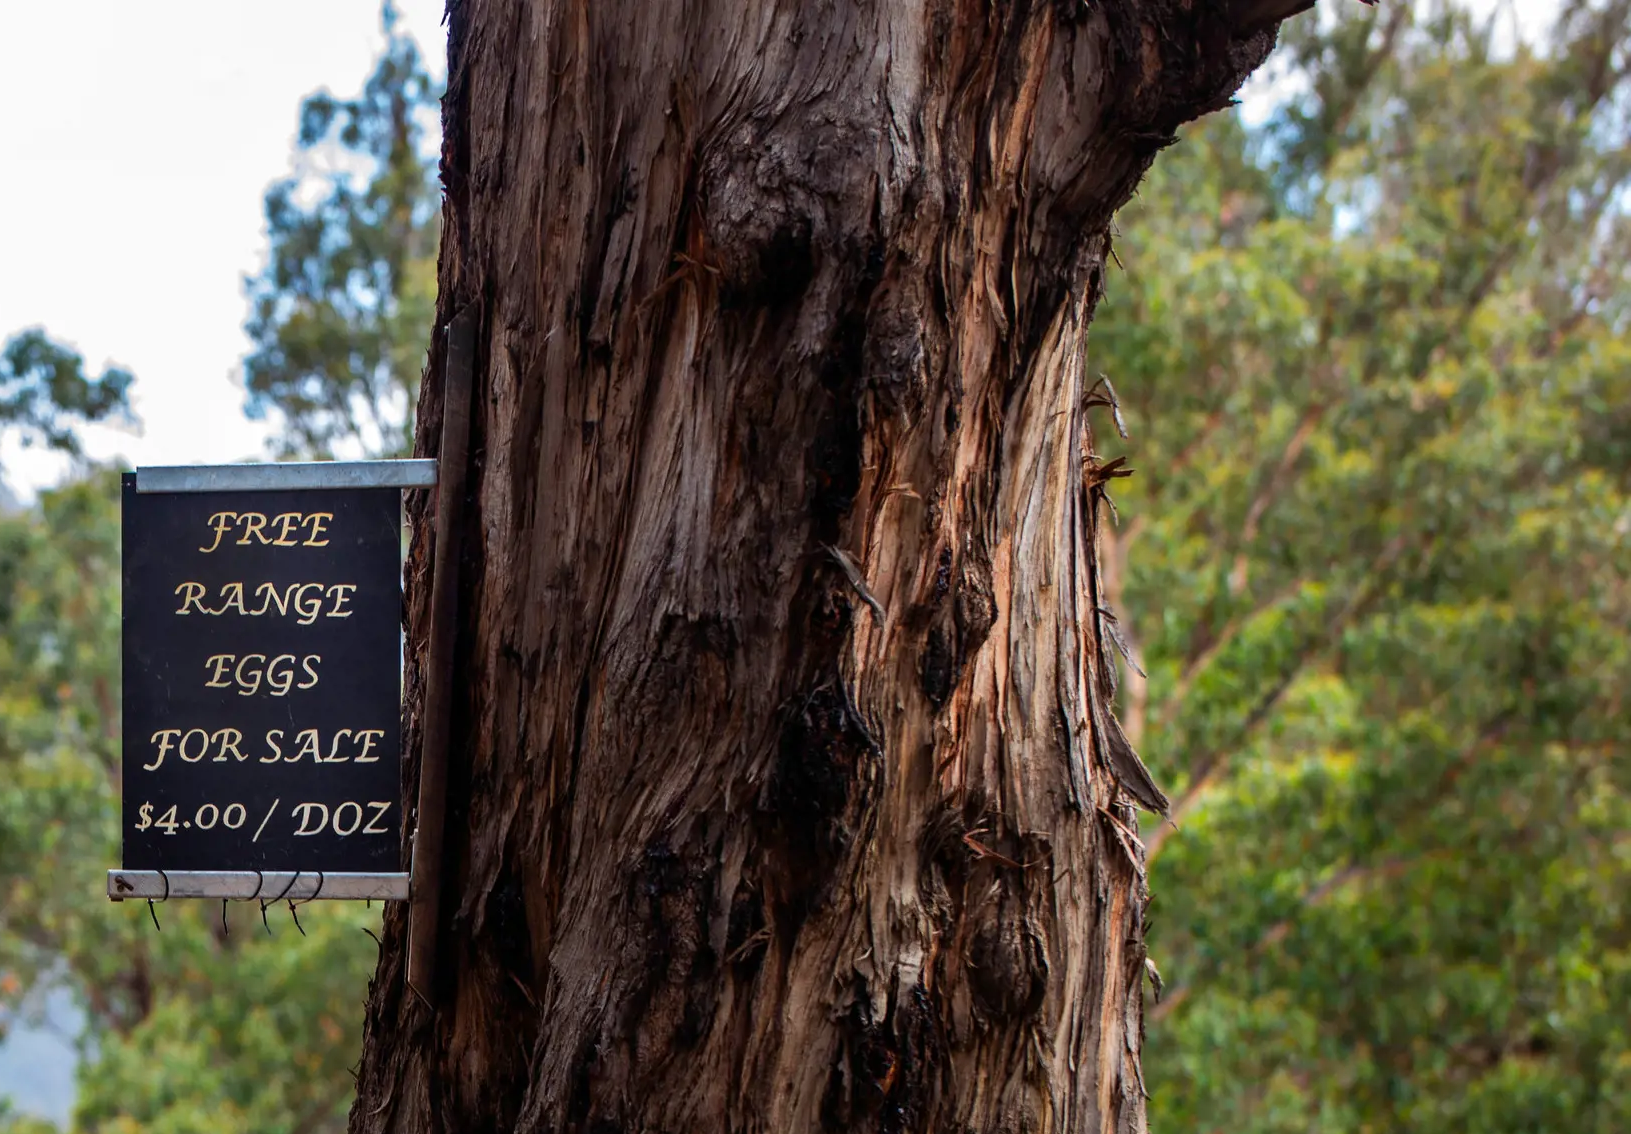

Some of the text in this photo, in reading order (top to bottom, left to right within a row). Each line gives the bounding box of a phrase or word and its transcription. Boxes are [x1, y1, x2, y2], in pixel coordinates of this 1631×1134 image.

[199, 511, 334, 554] FREE
[174, 582, 357, 625] RANGE
[204, 654, 322, 697] EGGS
[143, 728, 385, 772] FOR SALE
[134, 800, 247, 836] $4.00
[291, 800, 392, 837] DOZ
